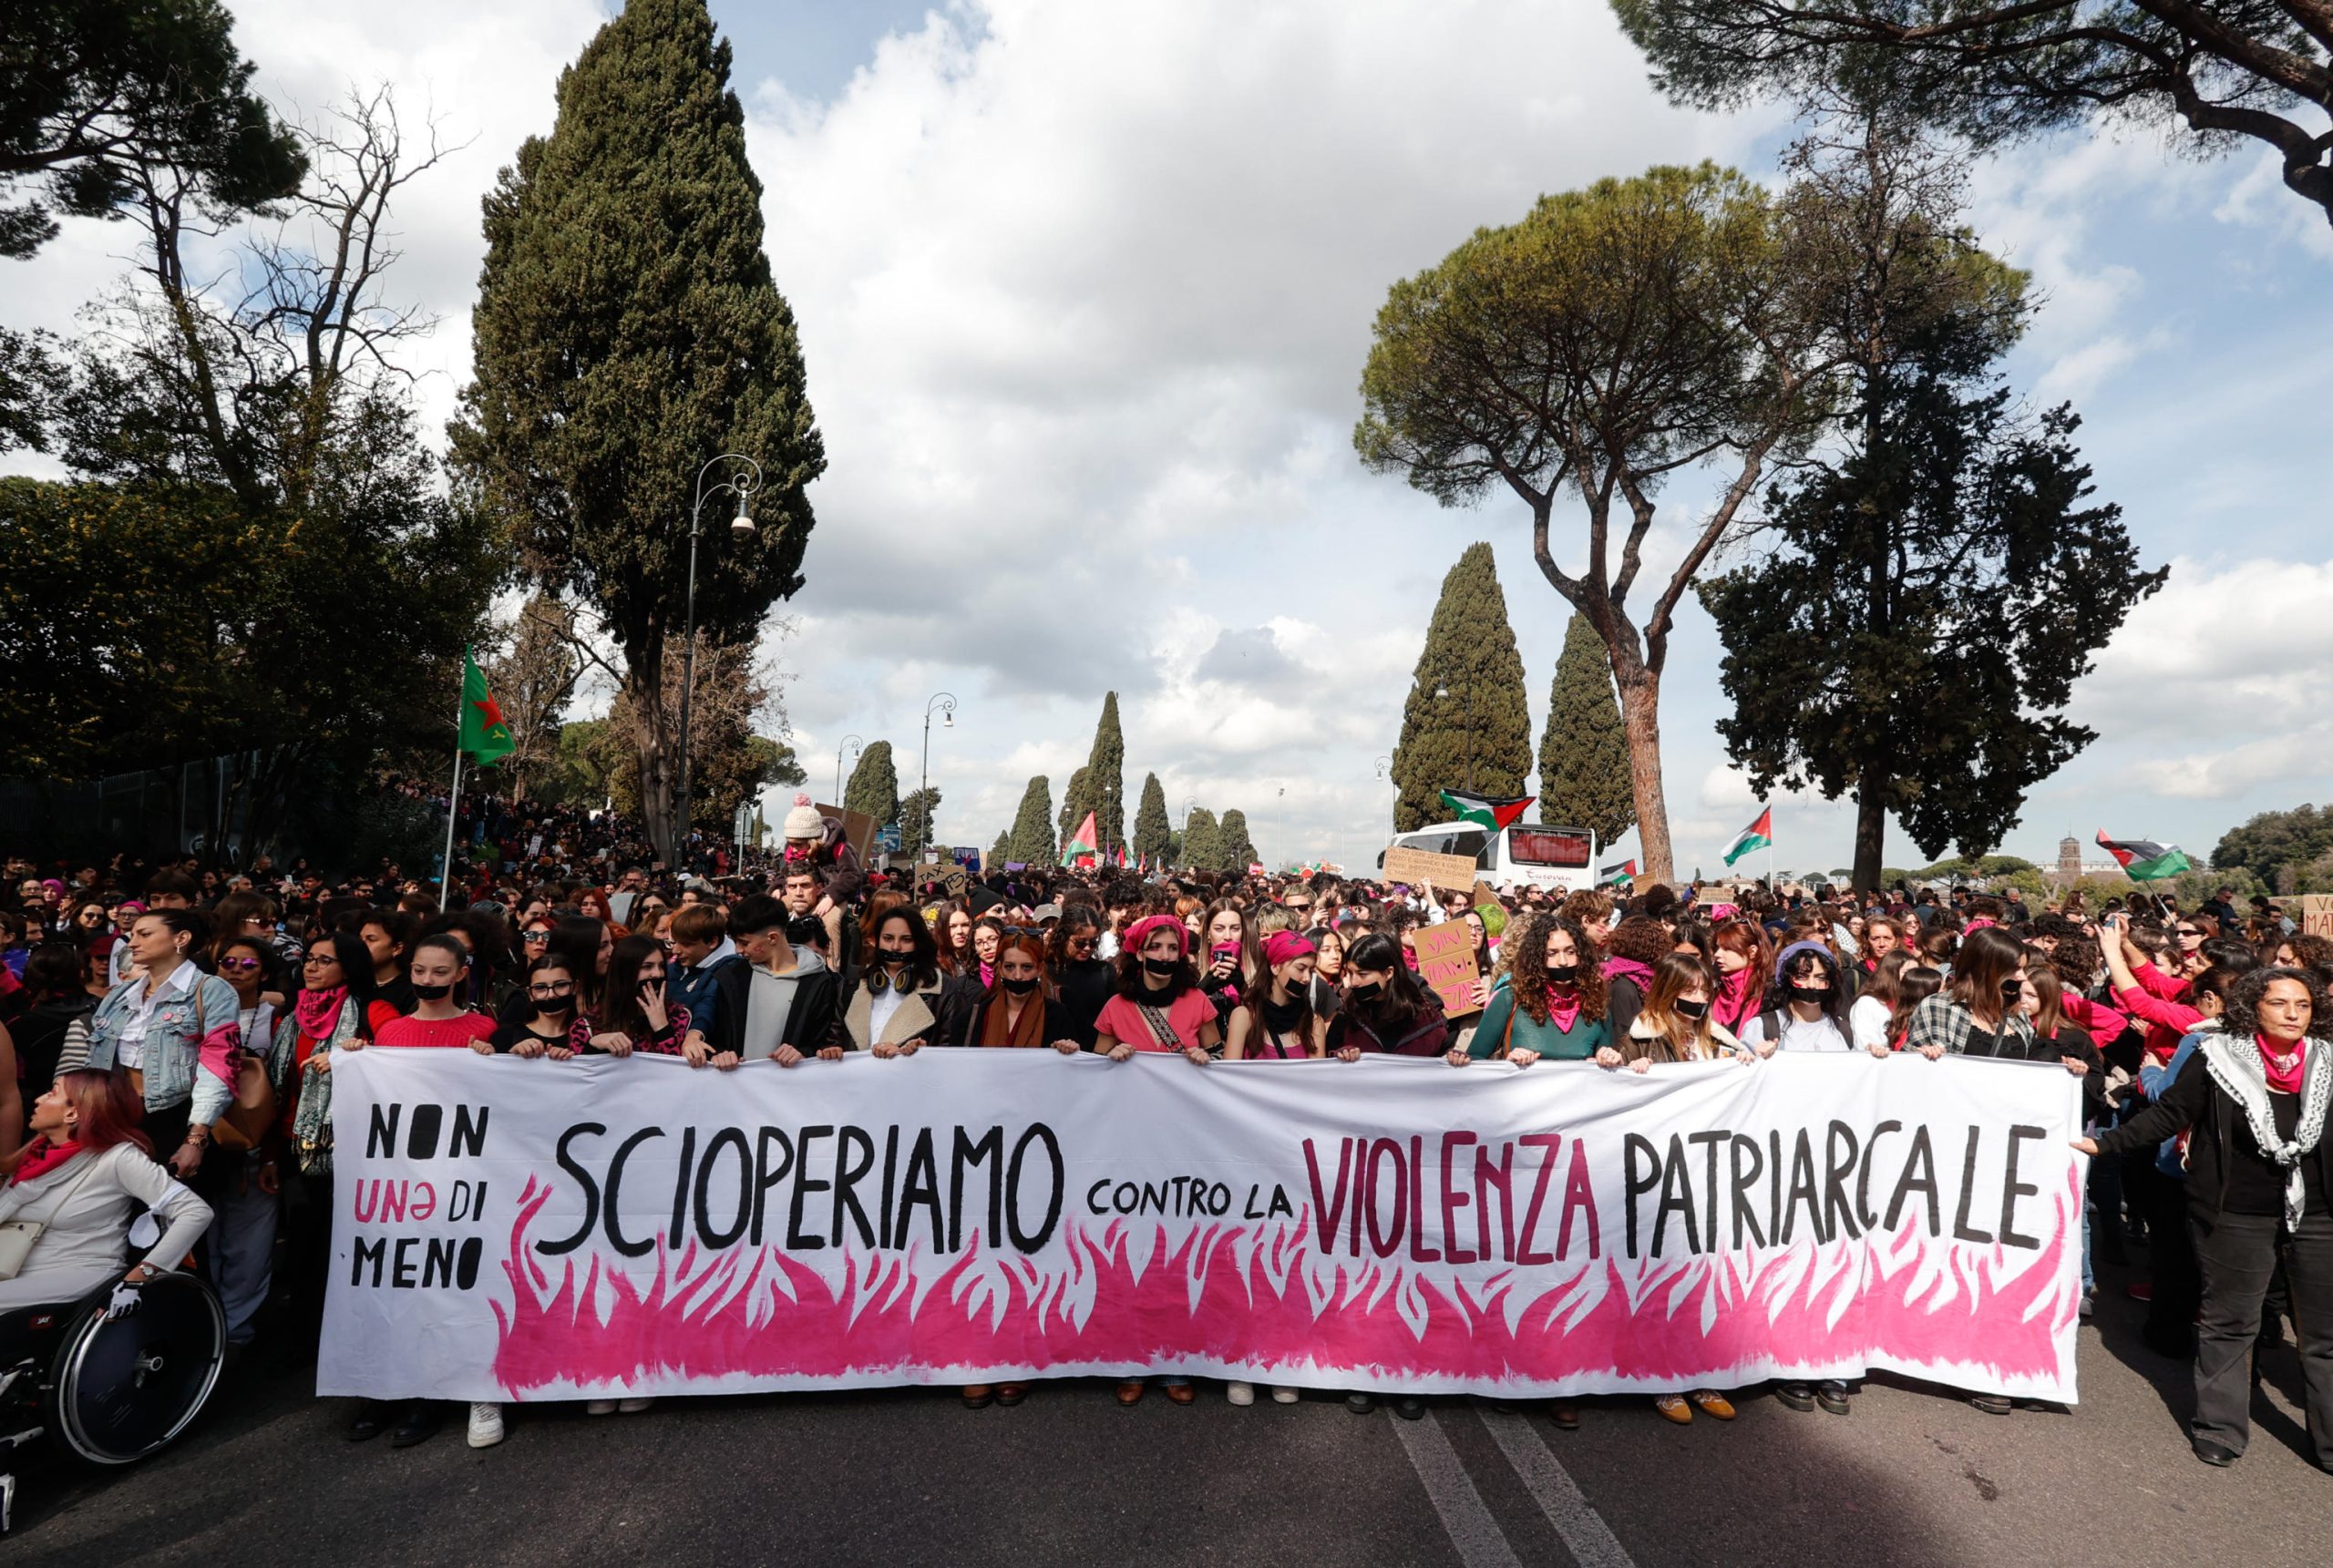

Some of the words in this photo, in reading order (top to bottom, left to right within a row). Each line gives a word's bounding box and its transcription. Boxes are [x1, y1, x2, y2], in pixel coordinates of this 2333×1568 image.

[919, 866, 945, 883] TAX
[366, 1103, 488, 1159] NON
[447, 1180, 487, 1223] DI
[534, 1122, 1064, 1257] SCIOPERIAMO
[1086, 1175, 1231, 1218] CONTRO
[1243, 1184, 1293, 1219] LA
[1301, 1131, 1601, 1266] VIOLENZA
[1624, 1120, 2047, 1260] PATRIARCALE
[351, 1235, 484, 1291] MENO
